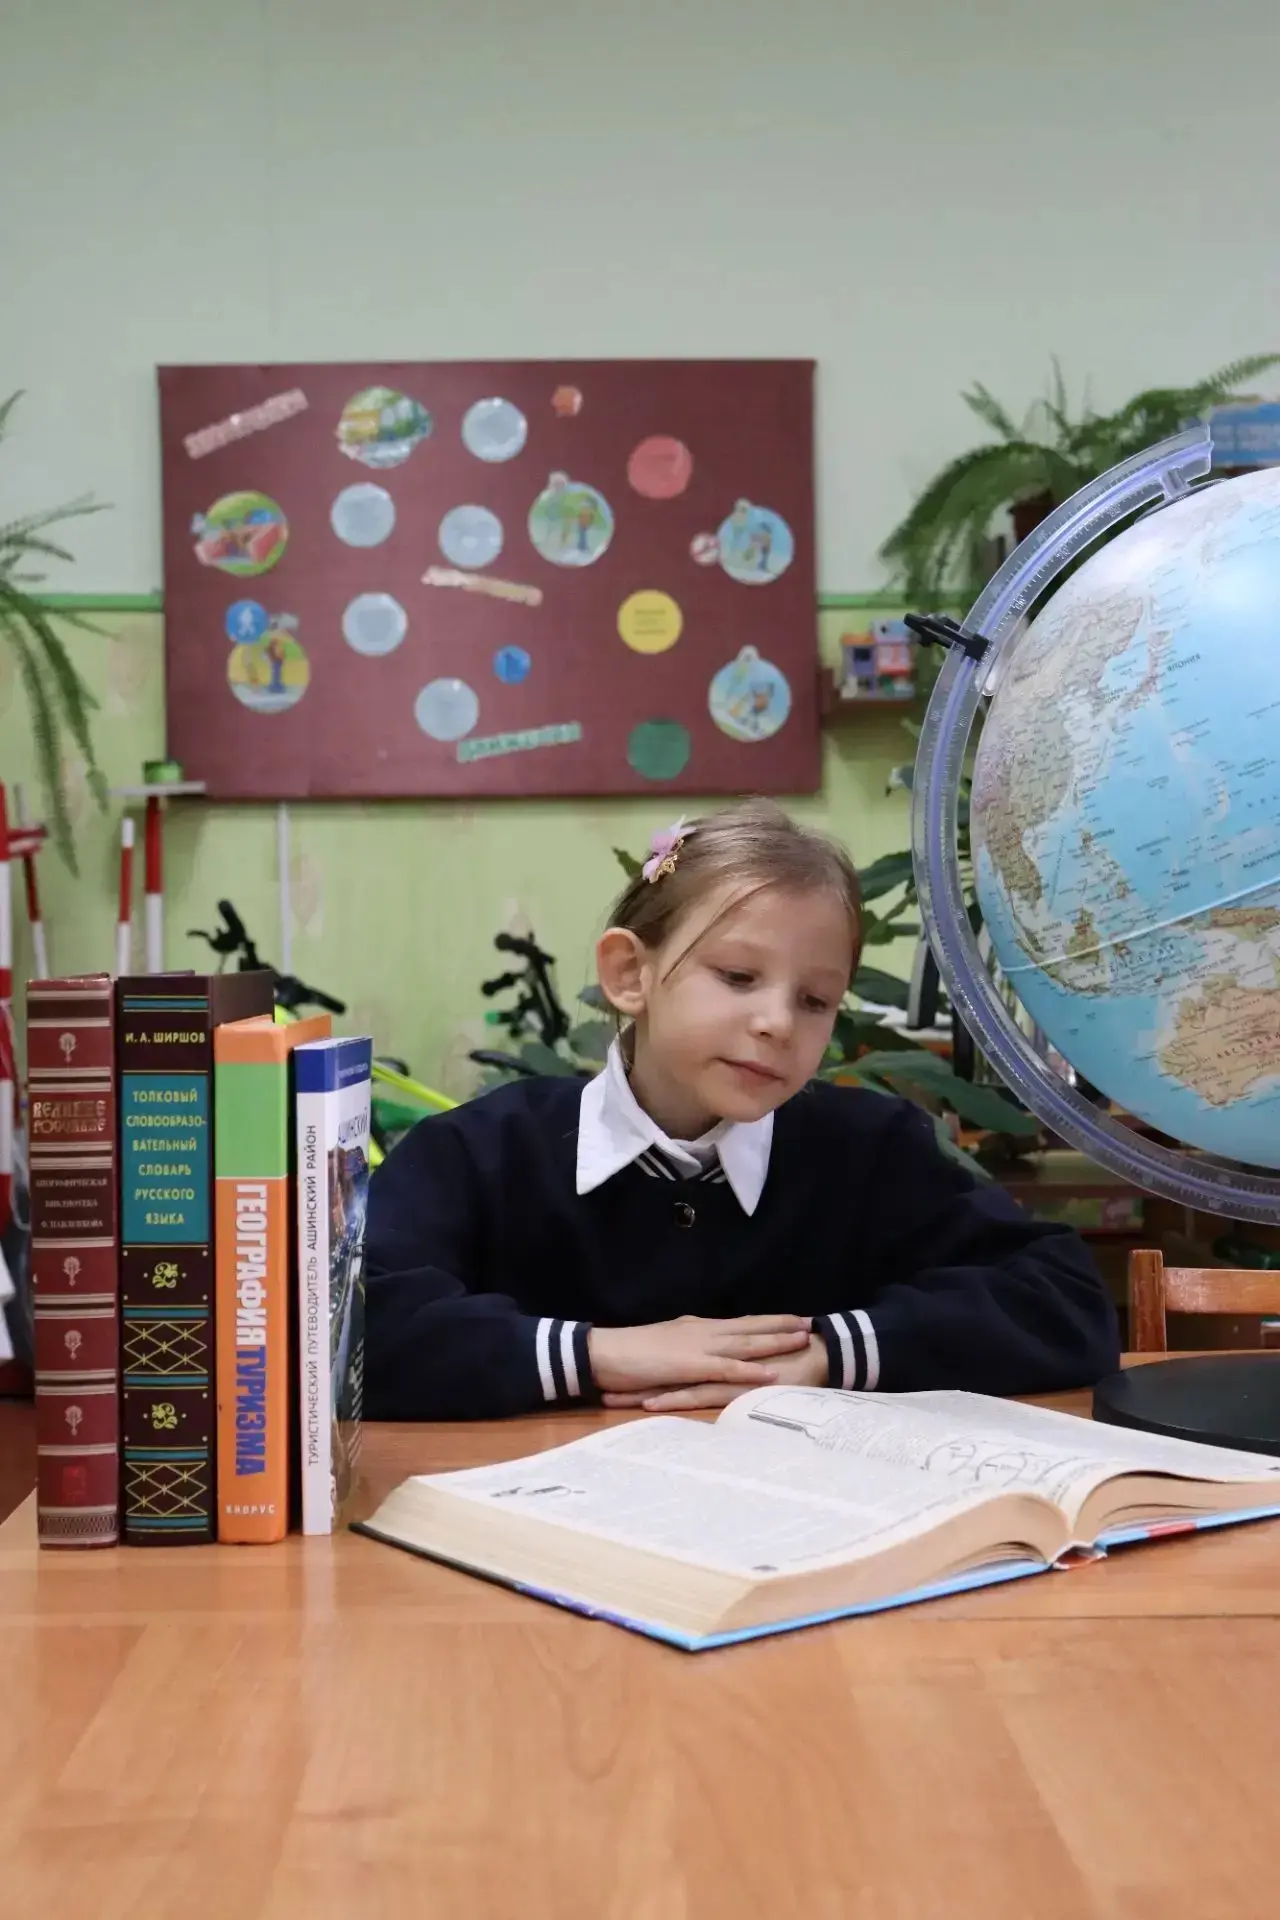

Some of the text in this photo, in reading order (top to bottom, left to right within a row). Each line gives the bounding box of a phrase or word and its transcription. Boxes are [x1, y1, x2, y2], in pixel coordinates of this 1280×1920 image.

[125, 1032, 206, 1043] И. А. ШИРШОВ
[132, 1088, 198, 1102] ТОЛКОВЫЙ
[126, 1115, 206, 1127] СЛОВООБРАЗО-
[132, 1137, 197, 1151] ВАТЕЛЬНЫЙ
[138, 1164, 192, 1176] СЛОВАРЬ
[134, 1188, 195, 1200] РУССКОГО
[145, 1213, 185, 1225] ЯЗЫКА
[306, 1125, 319, 1466] ТУРИСТИЧЕСКИЙ ПУТЕВОДИТЕЛЬ АШИНСКИЙ РАЙОН
[235, 1184, 267, 1475] ГЕОГРАФИЯ ТУРИЗМА
